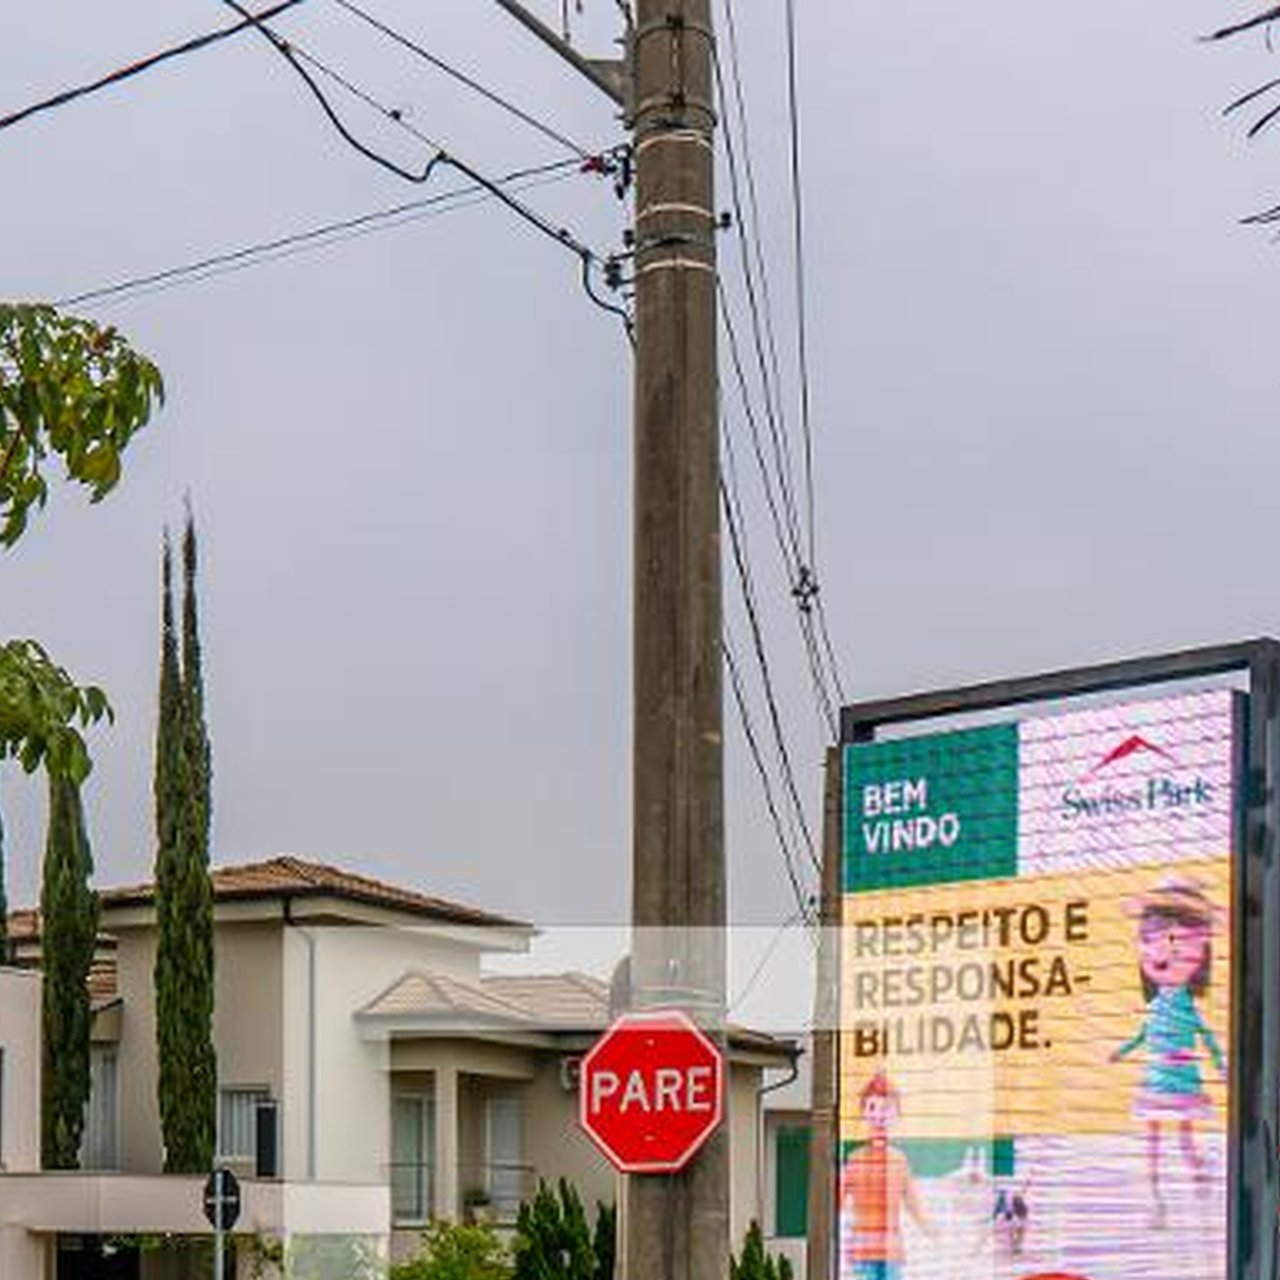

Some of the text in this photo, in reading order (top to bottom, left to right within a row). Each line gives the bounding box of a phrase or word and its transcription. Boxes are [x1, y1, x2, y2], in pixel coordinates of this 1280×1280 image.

[861, 777, 928, 815] BEM
[861, 812, 960, 853] VINDO
[853, 902, 1089, 957] RESPEITO E
[853, 955, 1091, 1009] RESPONSA-
[853, 1009, 1052, 1058] BILIDADE.
[590, 1066, 711, 1115] PARE
